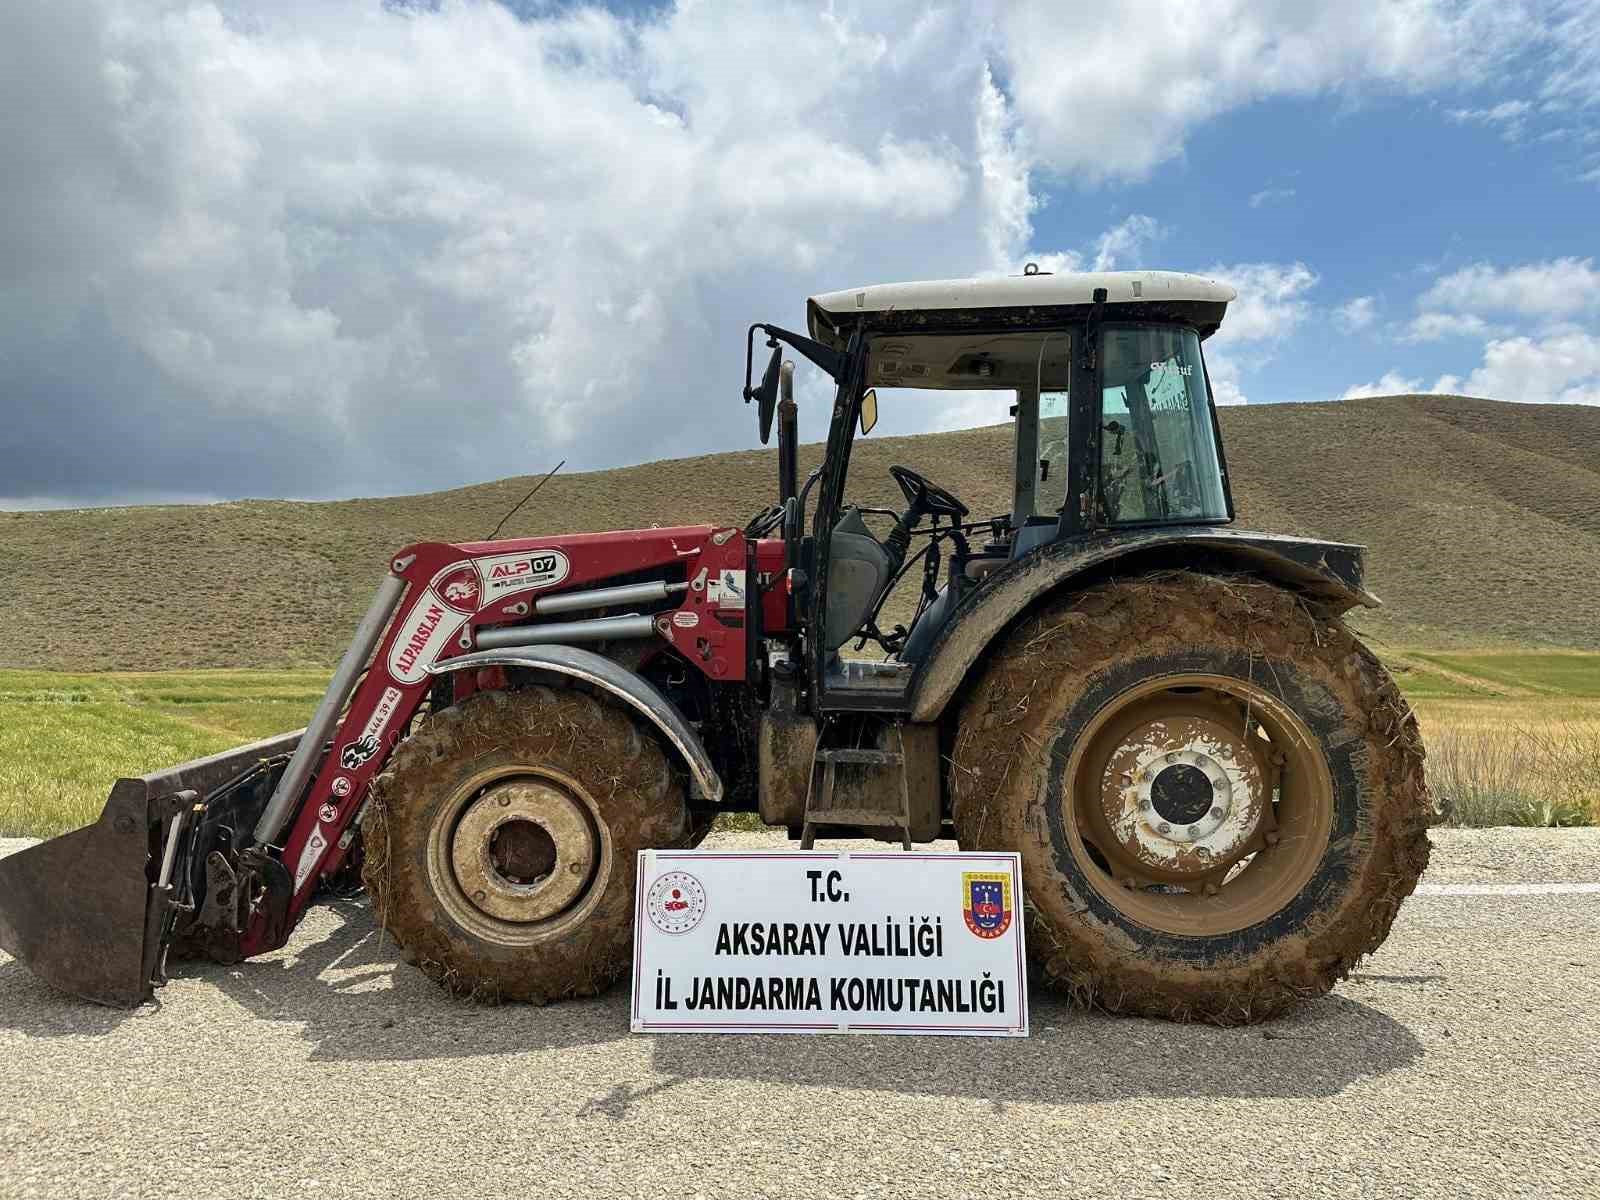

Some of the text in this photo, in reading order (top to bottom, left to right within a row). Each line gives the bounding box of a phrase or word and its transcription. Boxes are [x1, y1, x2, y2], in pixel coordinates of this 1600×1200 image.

[492, 557, 554, 578] ALP 07
[395, 603, 445, 675] ALPARSLAN
[369, 690, 399, 734] 444 39 42
[806, 870, 850, 902] T.C.
[714, 915, 943, 957] AKSARAY VALİLİĞİ
[655, 968, 1005, 1014] İL JANDARMA KOMUTANLIĞI
